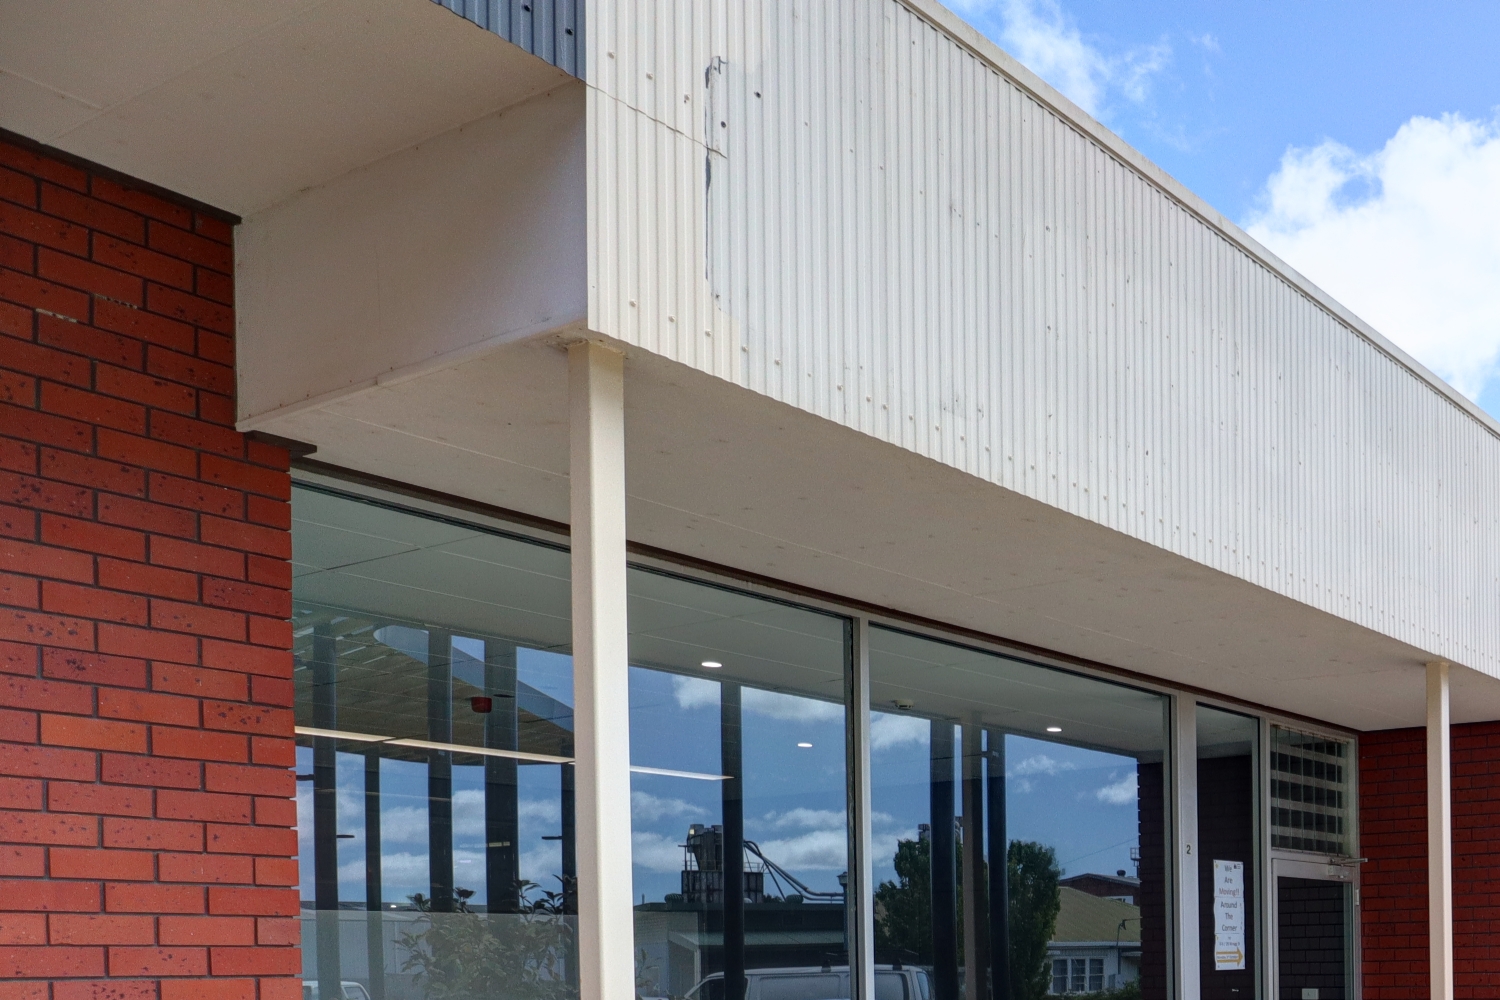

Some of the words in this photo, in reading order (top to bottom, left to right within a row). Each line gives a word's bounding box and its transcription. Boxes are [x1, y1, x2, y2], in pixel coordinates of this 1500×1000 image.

[1186, 844, 1191, 855] 2
[1224, 876, 1233, 884] Are
[1221, 901, 1238, 909] Around
[1225, 912, 1234, 920] The
[1221, 924, 1238, 932] Corner
